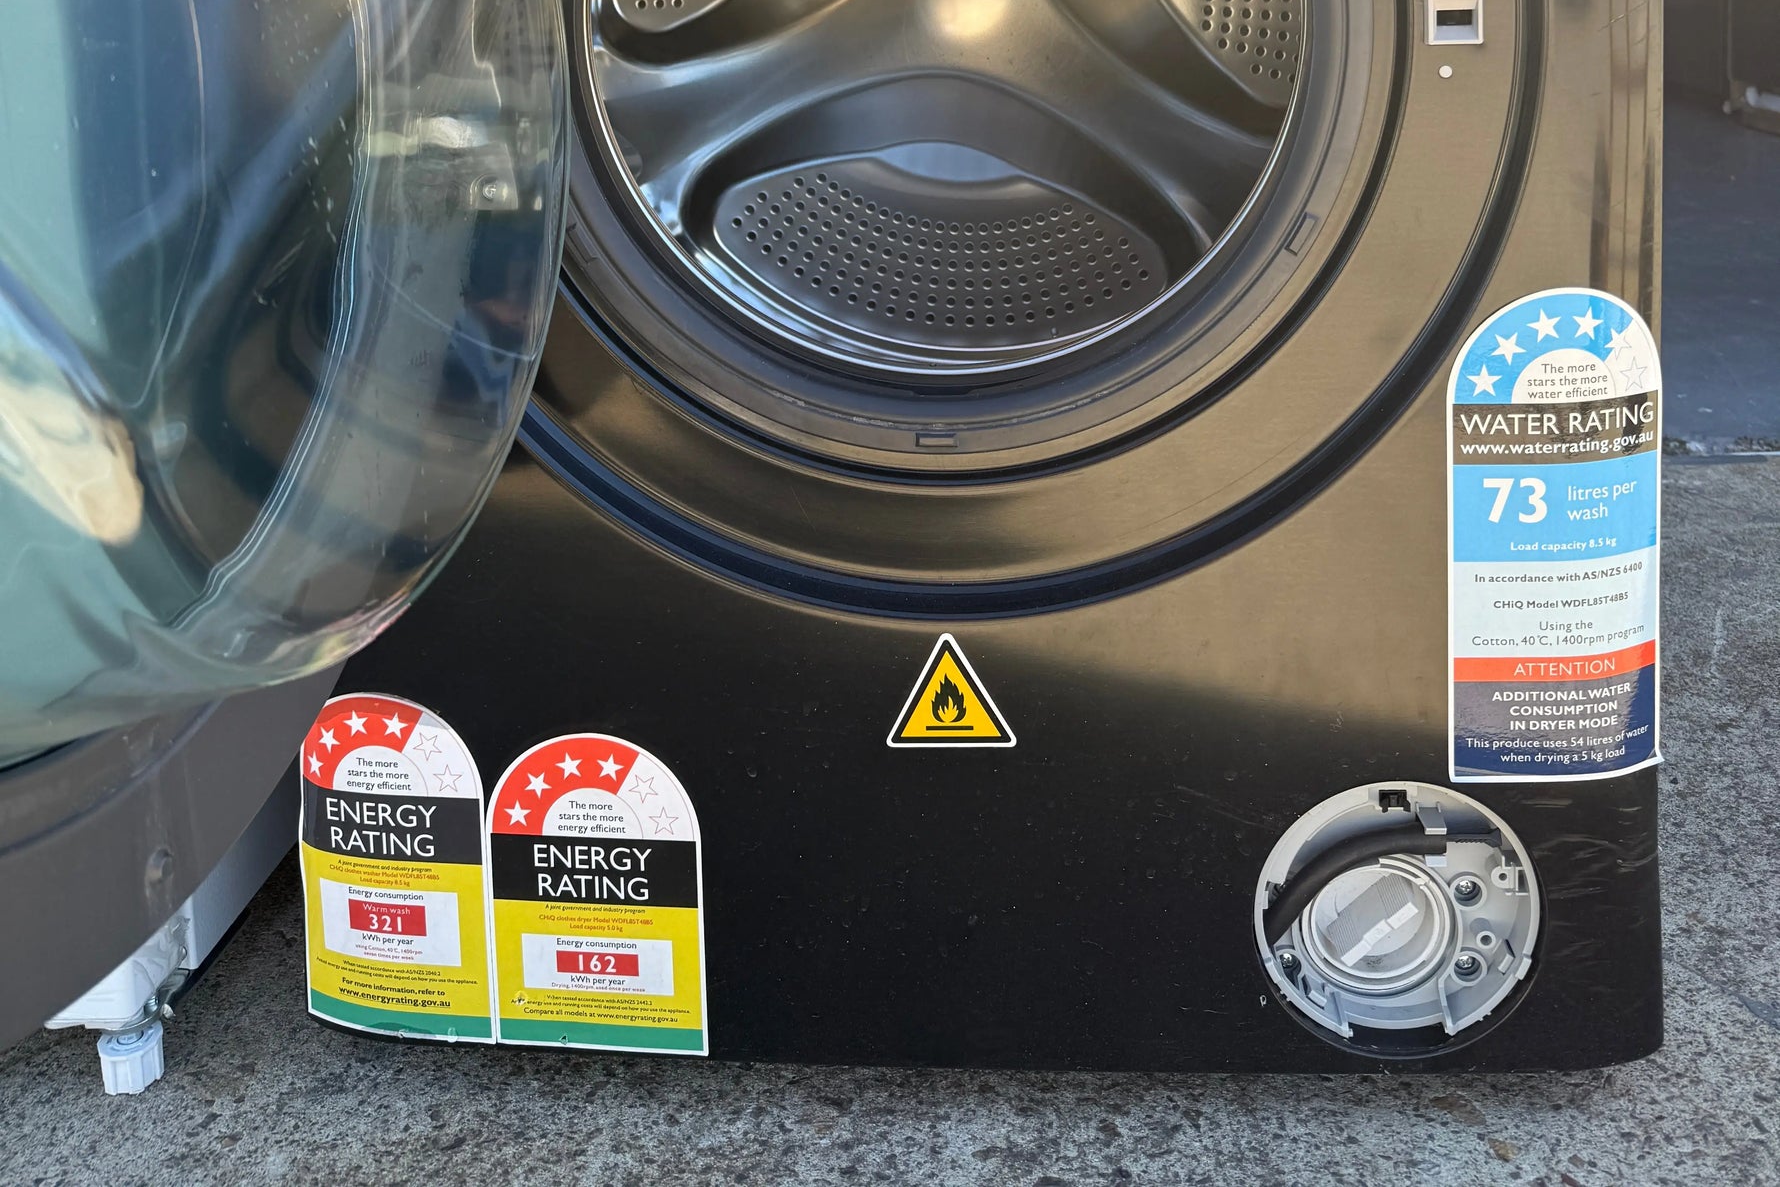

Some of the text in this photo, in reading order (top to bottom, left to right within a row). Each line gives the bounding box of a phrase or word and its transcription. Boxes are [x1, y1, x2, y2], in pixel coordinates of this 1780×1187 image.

[1541, 363, 1597, 374] The more
[1527, 374, 1608, 387] stars the more
[1527, 386, 1608, 399] water efficient
[1460, 401, 1655, 435] WATER RATING
[1460, 430, 1655, 455] www.waterrating.gov.au
[1482, 477, 1638, 524] 73 litres per
[1567, 503, 1609, 521] wash
[1510, 536, 1617, 553] Load capacity 8.5 kg
[1474, 561, 1643, 584] In accordance with AS/NZS 6400
[1493, 591, 1629, 611] CHiQ Model WDFL85T48B5
[1471, 635, 1519, 648] Cotton,
[1556, 633, 1605, 647] 1400rpm
[1607, 622, 1645, 644] program
[1539, 620, 1593, 633] Using the
[1513, 657, 1616, 677] ATTENTION
[1492, 681, 1631, 702] ADDITIONAL WATER
[1509, 700, 1618, 716] CONSUMPTION
[1510, 714, 1619, 731] IN DRYER MODE
[1465, 724, 1649, 751] This produce uses 54 litres of water
[356, 757, 399, 768] The more
[1500, 745, 1626, 765] when drying a 5 kg load
[347, 769, 409, 780] stars the more
[346, 780, 412, 791] energy efficient
[325, 797, 437, 829] ENERGY
[569, 800, 613, 811] The more
[559, 812, 624, 823] stars the more
[557, 824, 626, 834] energy efficient
[330, 826, 435, 858] RATING
[533, 843, 652, 872] ENERGY
[348, 886, 424, 902] Energy consumption
[537, 873, 649, 901] RATING
[362, 903, 411, 915] Warm wash
[369, 913, 402, 933] 321
[362, 933, 414, 947] kWh per year
[557, 937, 637, 950] Energy consumption
[578, 954, 617, 973] 162
[342, 976, 353, 985] For
[354, 981, 372, 990] more
[373, 983, 418, 995] information,
[418, 988, 436, 996] refer
[570, 975, 591, 983] kWh
[608, 978, 626, 987] year
[338, 986, 451, 1008] www.energyrating.gov.au
[523, 1007, 555, 1016] Compare
[564, 1010, 588, 1018] models
[596, 1013, 678, 1023] www.energyrating.gov.au
